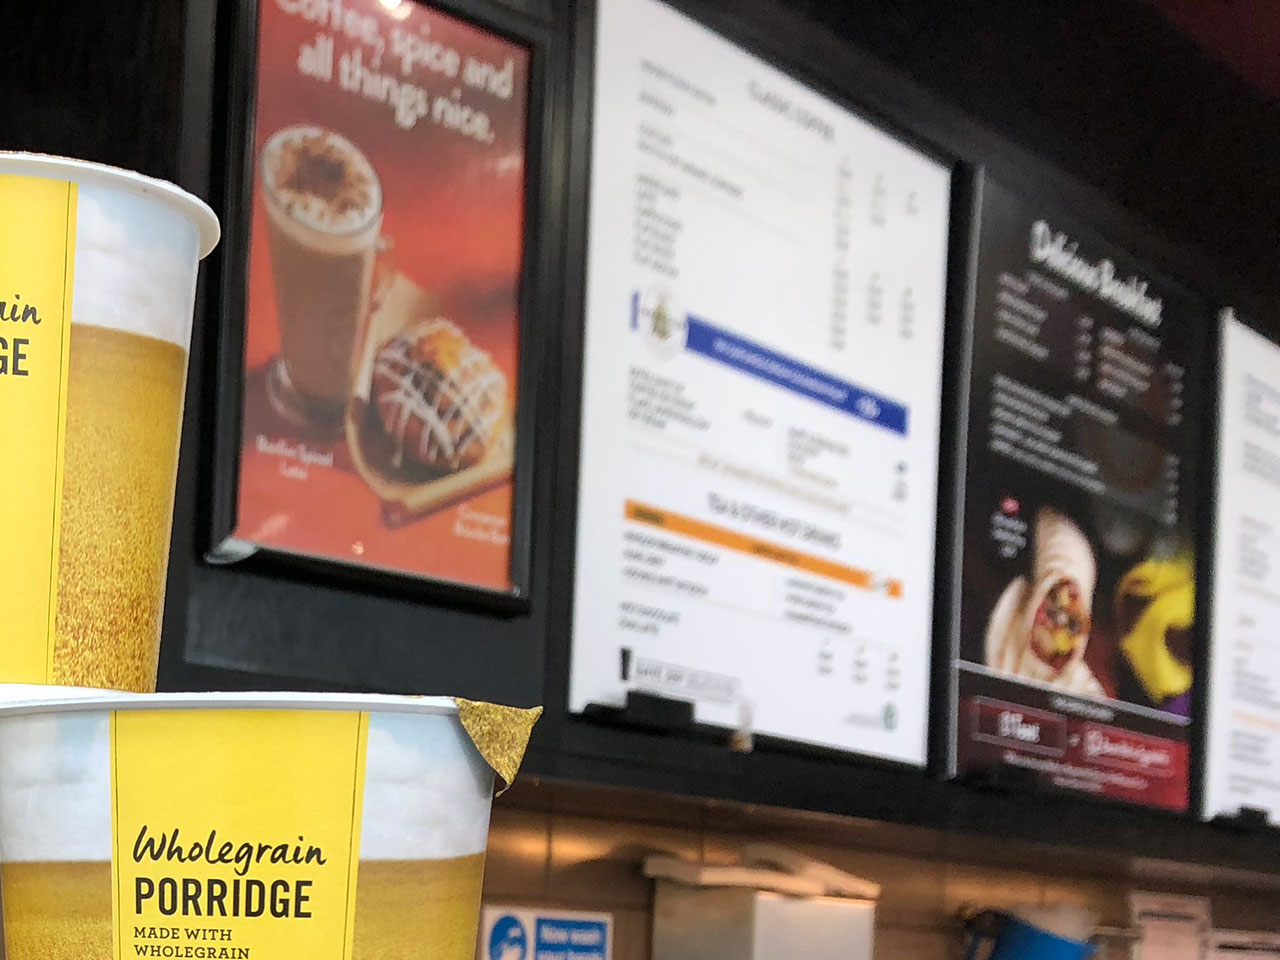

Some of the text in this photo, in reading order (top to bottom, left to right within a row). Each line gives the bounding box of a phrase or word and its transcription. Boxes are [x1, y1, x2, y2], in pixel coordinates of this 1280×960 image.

[298, 34, 334, 81] all
[339, 49, 429, 129] things
[392, 23, 460, 77] spice
[463, 57, 515, 99] and
[132, 824, 327, 877] Wholegrain
[135, 877, 313, 919] PORRIDGE
[133, 926, 232, 941] MADE WITH
[133, 944, 250, 960] WHOLEGRAIN
